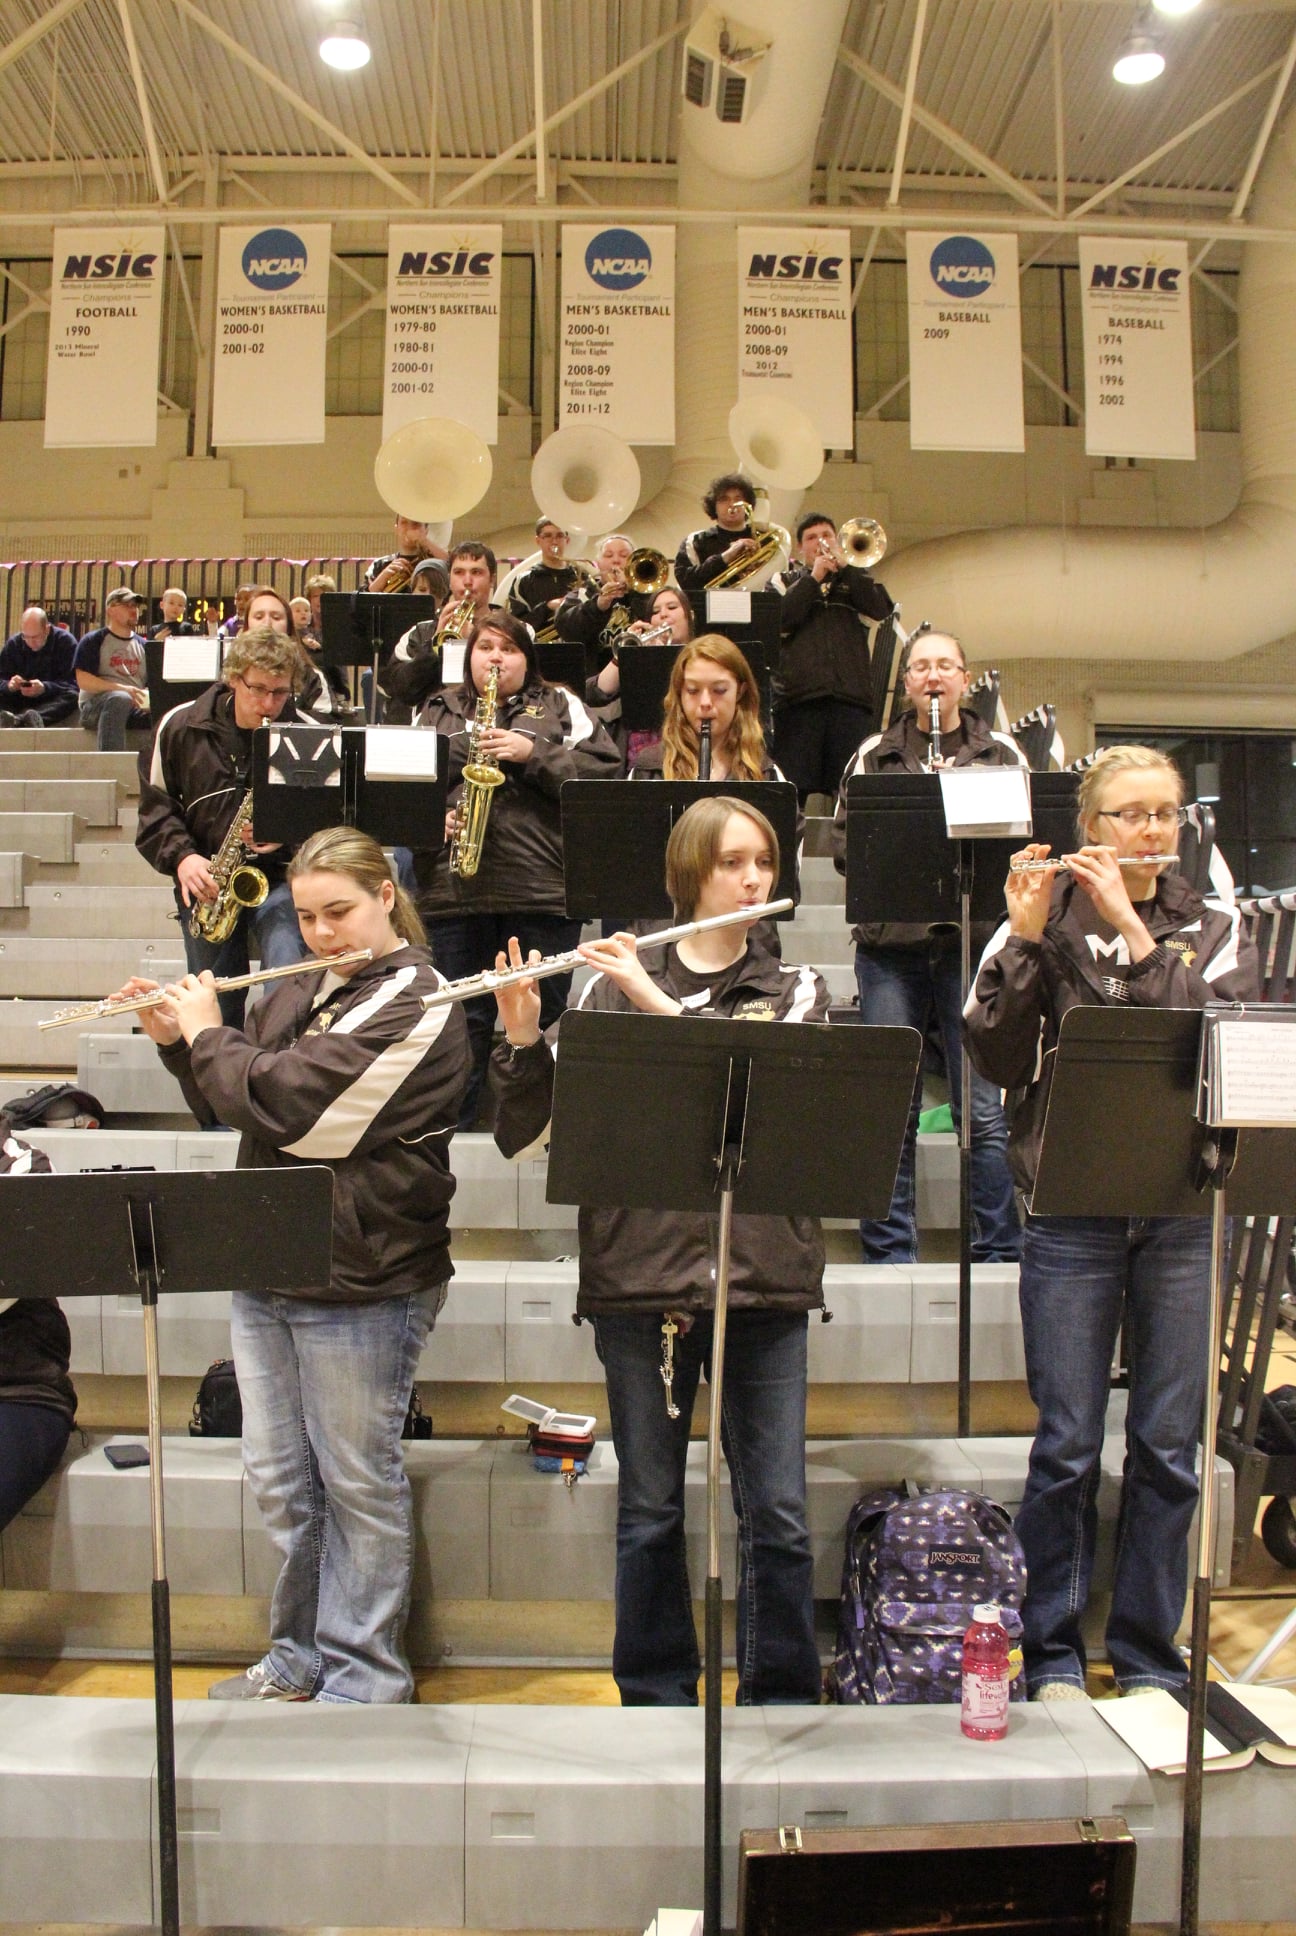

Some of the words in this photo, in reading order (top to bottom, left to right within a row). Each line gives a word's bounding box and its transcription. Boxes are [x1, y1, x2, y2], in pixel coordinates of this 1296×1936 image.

[63, 254, 158, 278] NSIC
[248, 258, 305, 276] NCAA
[398, 252, 495, 276] NSIC
[591, 258, 650, 276] NCAA
[748, 254, 843, 280] NSIC
[937, 265, 993, 283] NCAA
[1091, 264, 1182, 291] NSIC
[76, 307, 138, 318] FOOTBALL
[220, 306, 266, 316] WOMEN'S
[269, 304, 326, 315] BASKETBALL
[390, 305, 436, 315] WOMEN'S
[439, 304, 498, 315] BASKETBALL
[566, 305, 600, 316] MEN'S
[604, 305, 671, 316] BASKETBALL
[743, 307, 777, 318] MEN'S
[781, 308, 847, 320] BASKETBALL
[938, 312, 991, 323] BASEBALL
[223, 324, 264, 334] 2000-01
[394, 322, 436, 333] 1979-80
[1108, 317, 1165, 330] BASEBALL
[66, 326, 91, 336] 1990
[568, 324, 609, 335] 2000-01
[745, 324, 787, 335] 2000-01
[924, 328, 950, 339] 2009
[1098, 334, 1122, 345] 1974
[222, 343, 264, 354] 2001-02
[393, 342, 434, 353] 1980-81
[745, 344, 788, 356] 2008-09
[756, 361, 778, 370] 2012
[1099, 355, 1123, 365] 1994
[391, 362, 433, 373] 2000-01
[567, 365, 611, 375] 2008-09
[1100, 375, 1124, 386] 1996
[391, 382, 434, 394] 2001-02
[1099, 394, 1125, 405] 2002
[567, 403, 610, 414] 2011-12
[1165, 939, 1191, 951] SMSU
[742, 1001, 772, 1011] SMSU
[929, 1551, 980, 1565] JANSPORT
